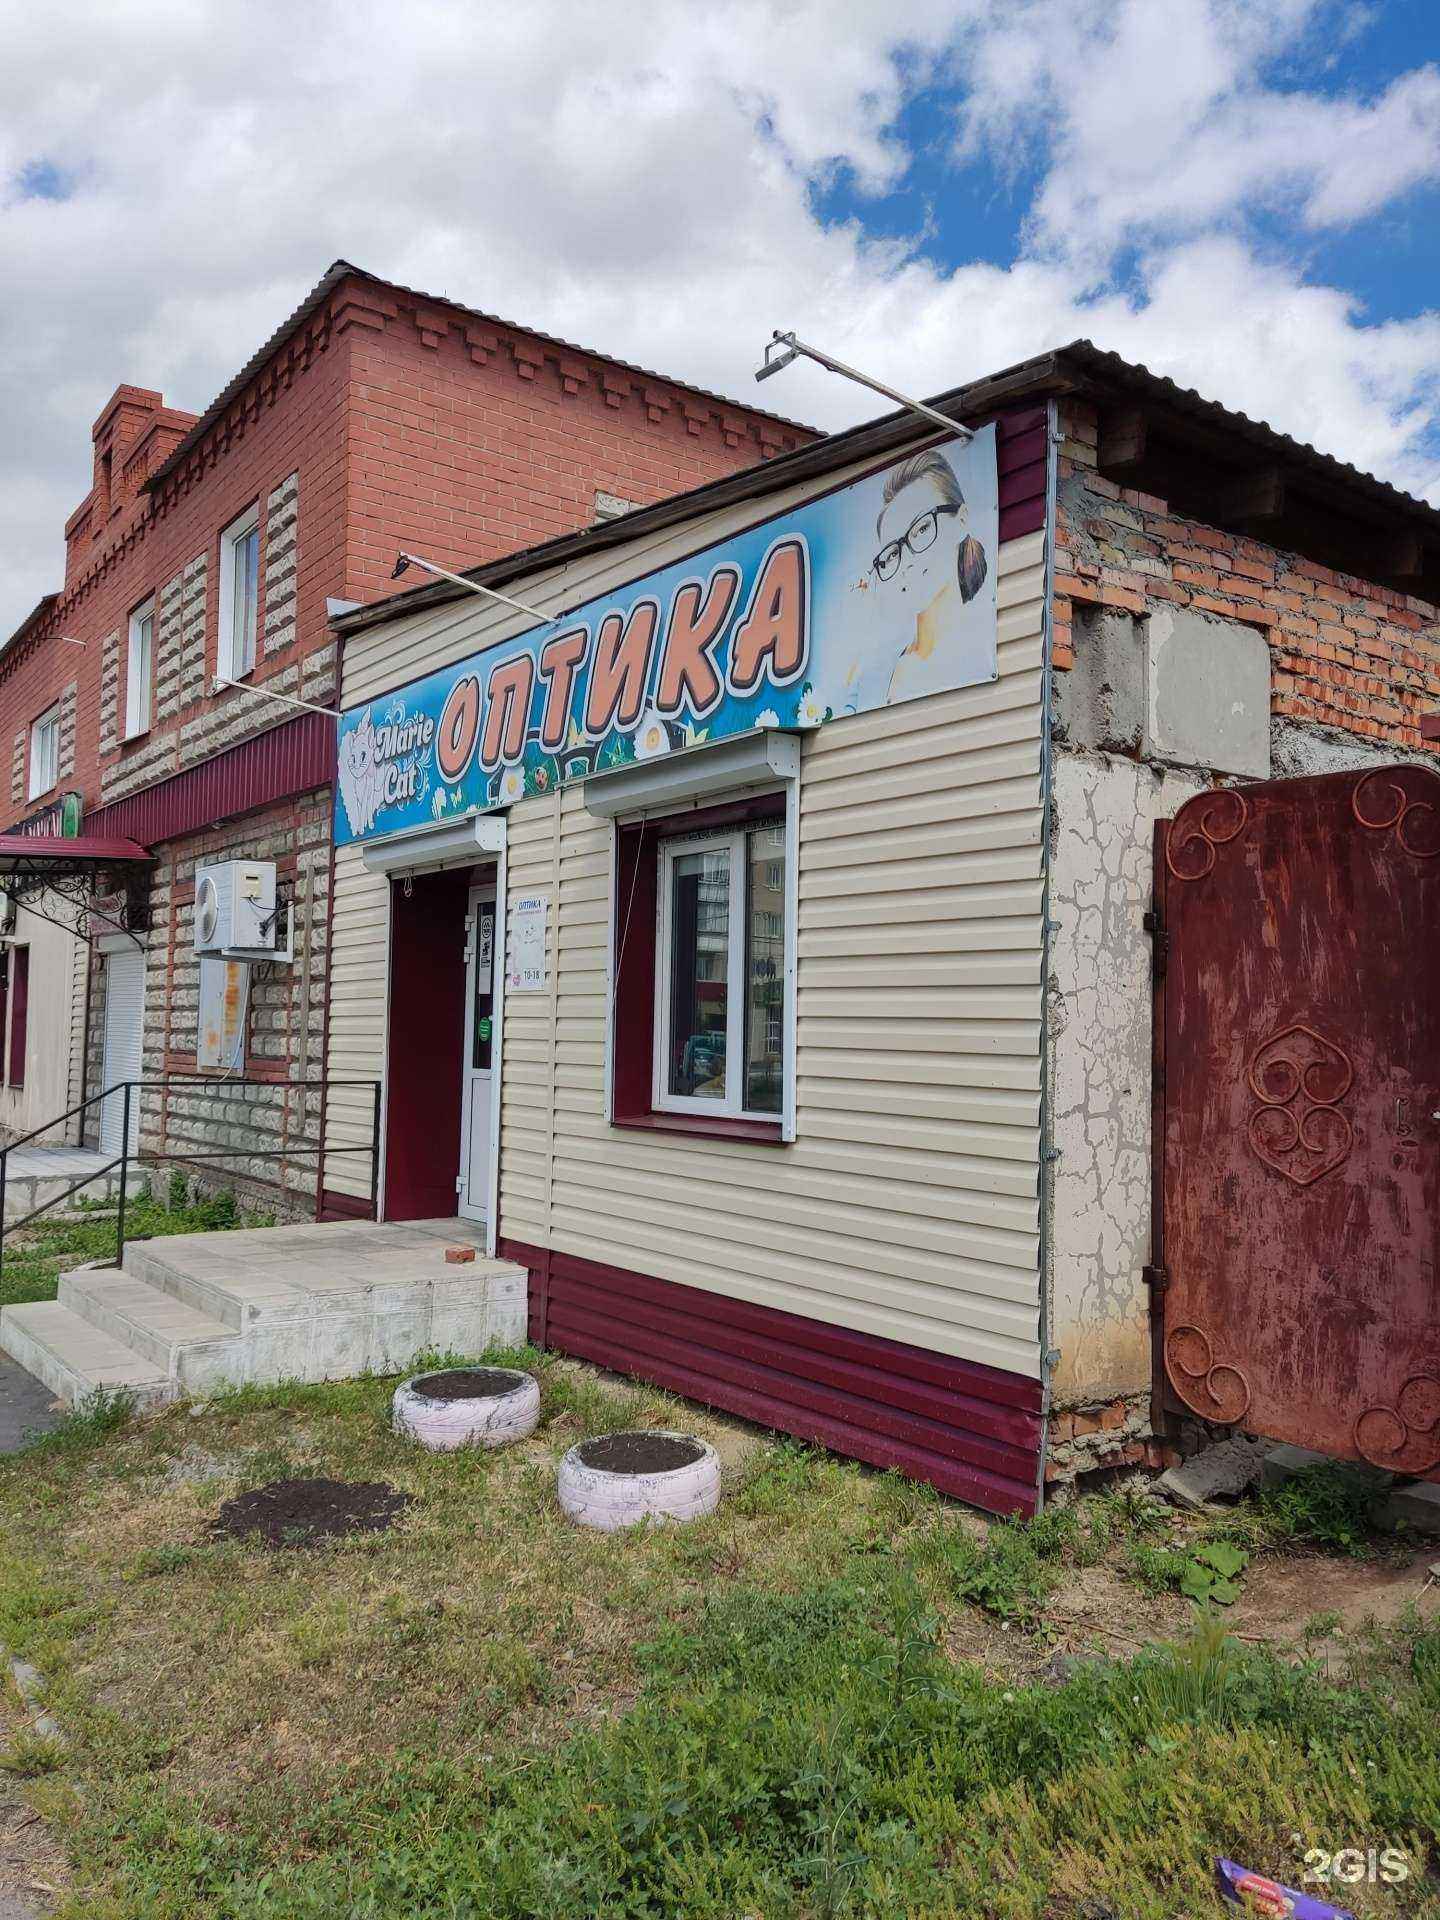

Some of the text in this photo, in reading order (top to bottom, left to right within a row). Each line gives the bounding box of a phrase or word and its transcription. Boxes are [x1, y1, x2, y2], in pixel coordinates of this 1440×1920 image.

[436, 533, 812, 784] ОПТИКА
[373, 713, 434, 765] Marie
[384, 762, 416, 804] Cat
